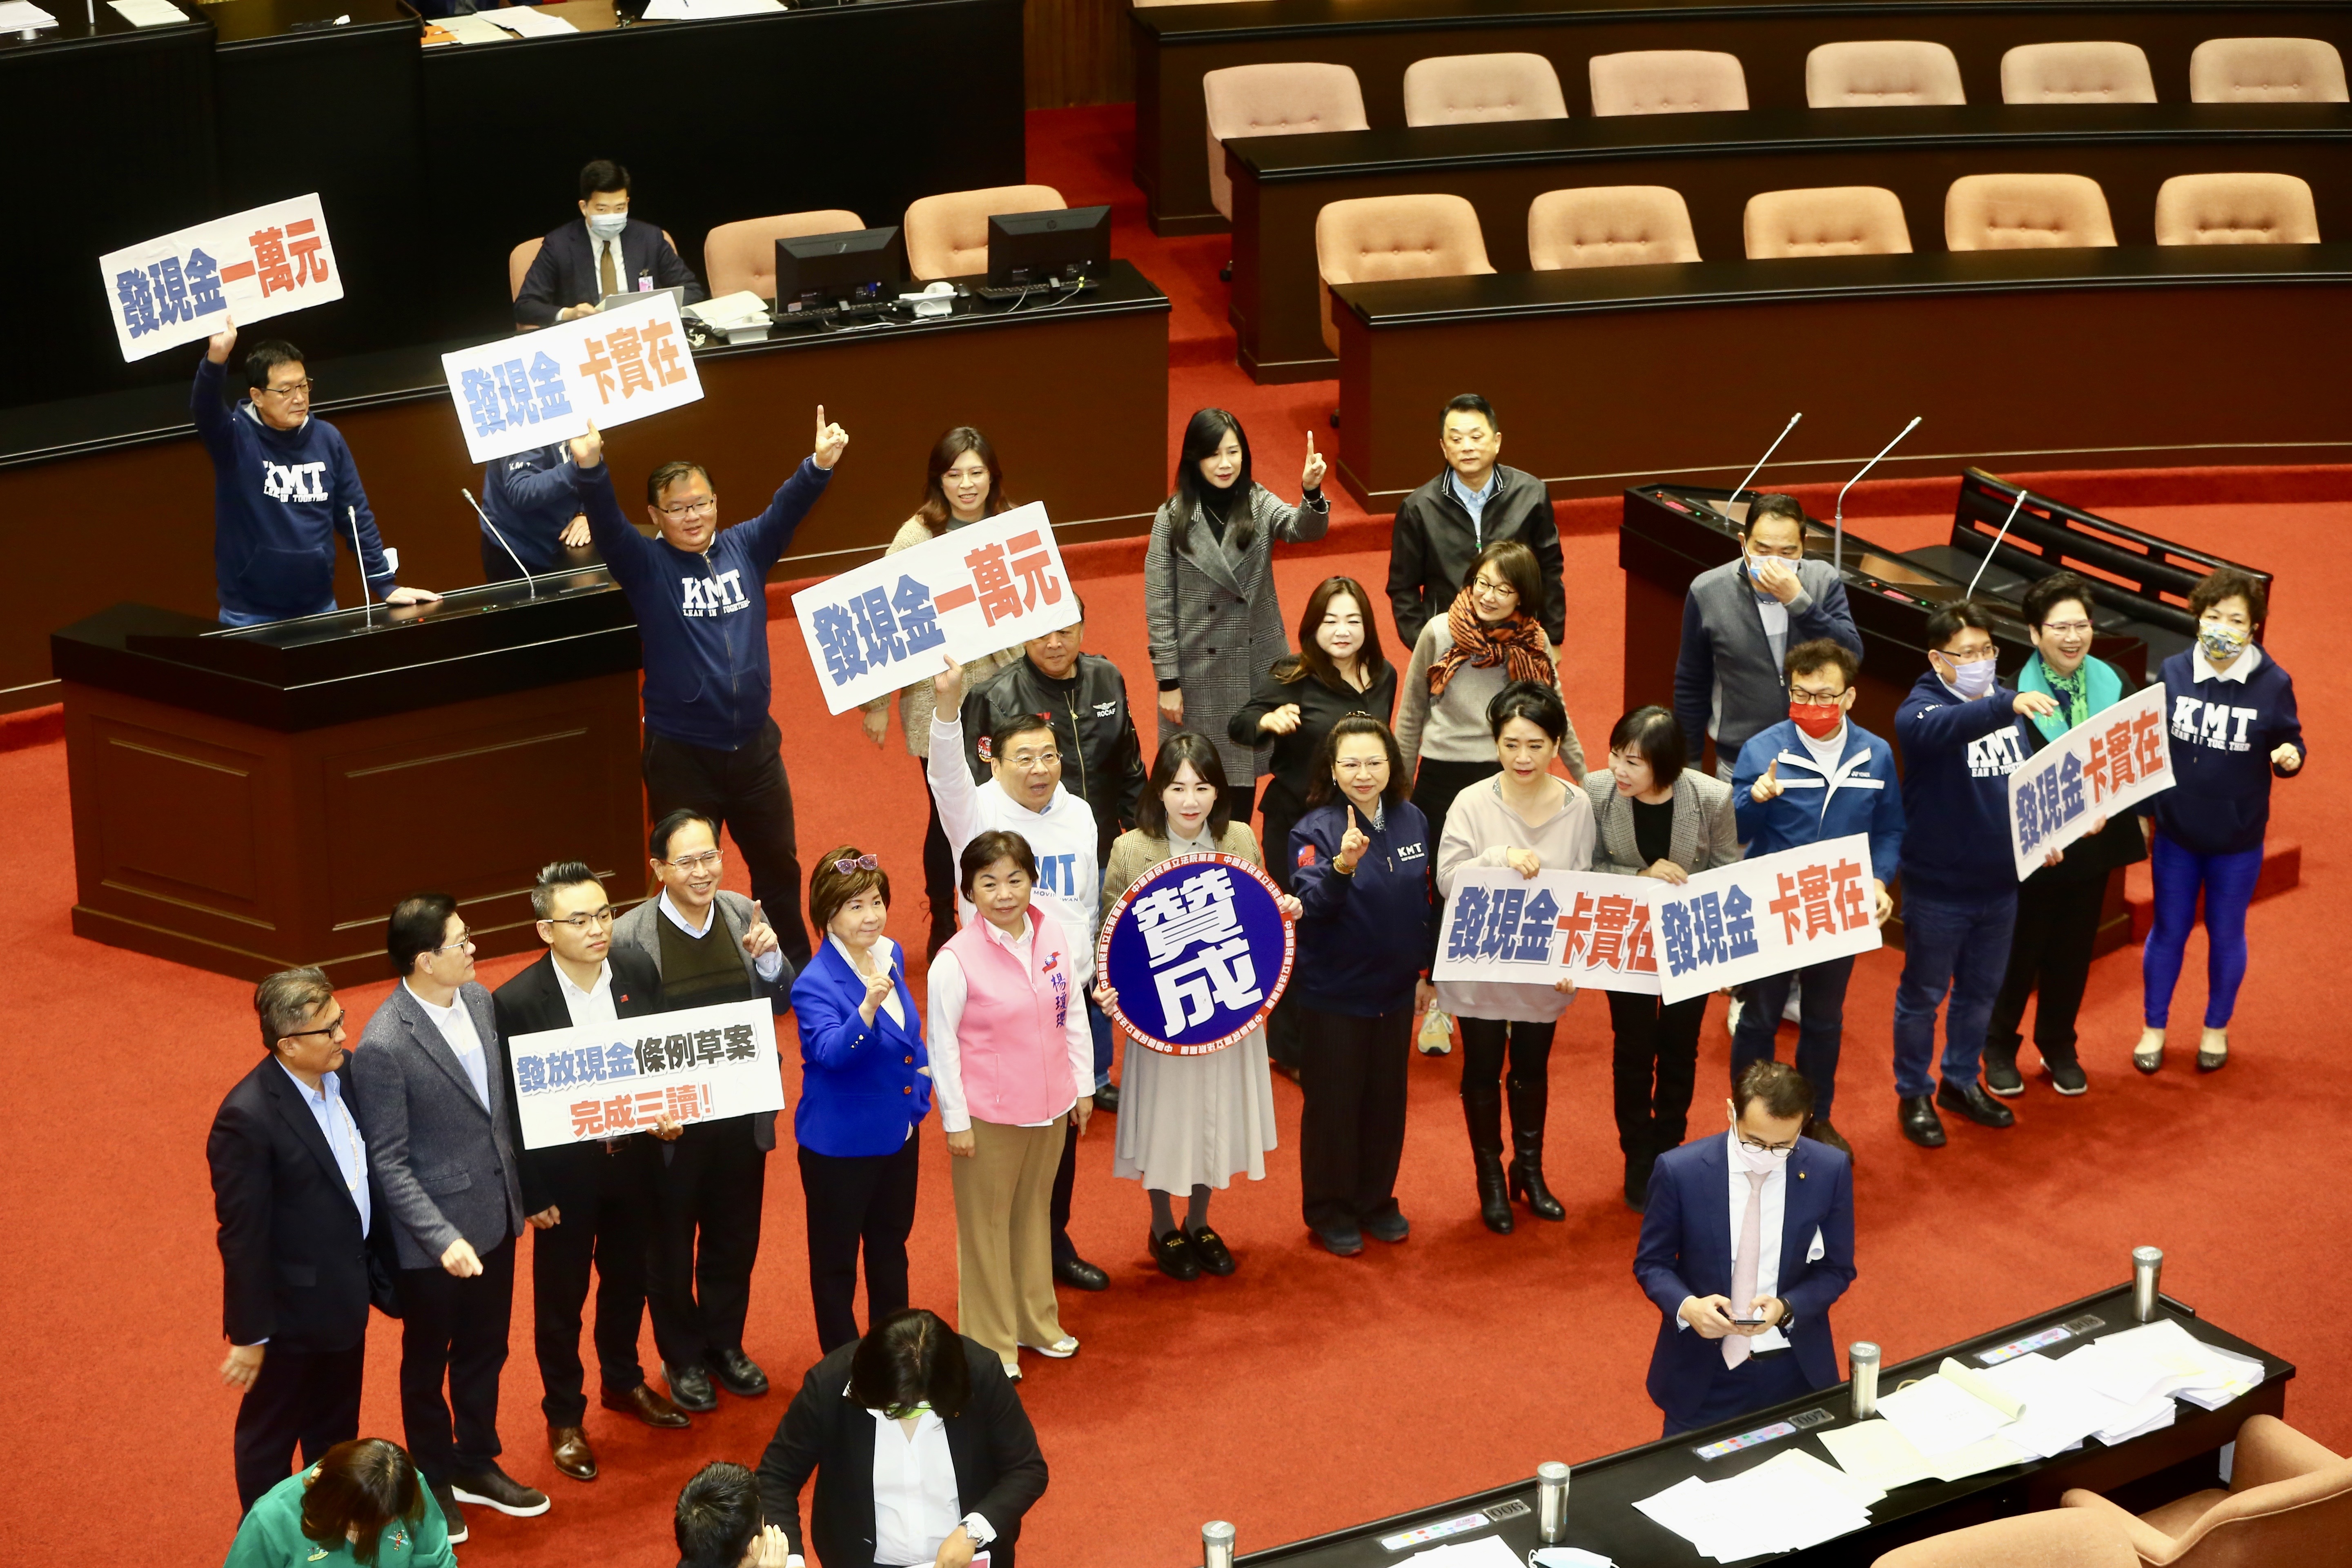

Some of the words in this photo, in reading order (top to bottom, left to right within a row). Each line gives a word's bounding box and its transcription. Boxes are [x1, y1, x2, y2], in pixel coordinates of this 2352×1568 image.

[116, 218, 328, 339] 發現金一萬元
[263, 461, 326, 494] KMT
[682, 569, 745, 609] KMT
[683, 609, 704, 617] LEAN
[708, 608, 717, 617] IN
[812, 530, 1061, 686] 發現金一萬元
[1097, 708, 1116, 717] ROCAF
[2172, 695, 2258, 743] KMT
[1967, 725, 2023, 768] KMT
[2207, 737, 2251, 751] TOGTHER
[1971, 767, 1989, 777] EAN
[1397, 842, 1421, 858] KMT
[1131, 867, 1263, 1038] 贊成
[517, 1024, 757, 1093] 發放現金條例草案
[1797, 1410, 1826, 1424] 007
[1491, 1502, 1524, 1517] 006
